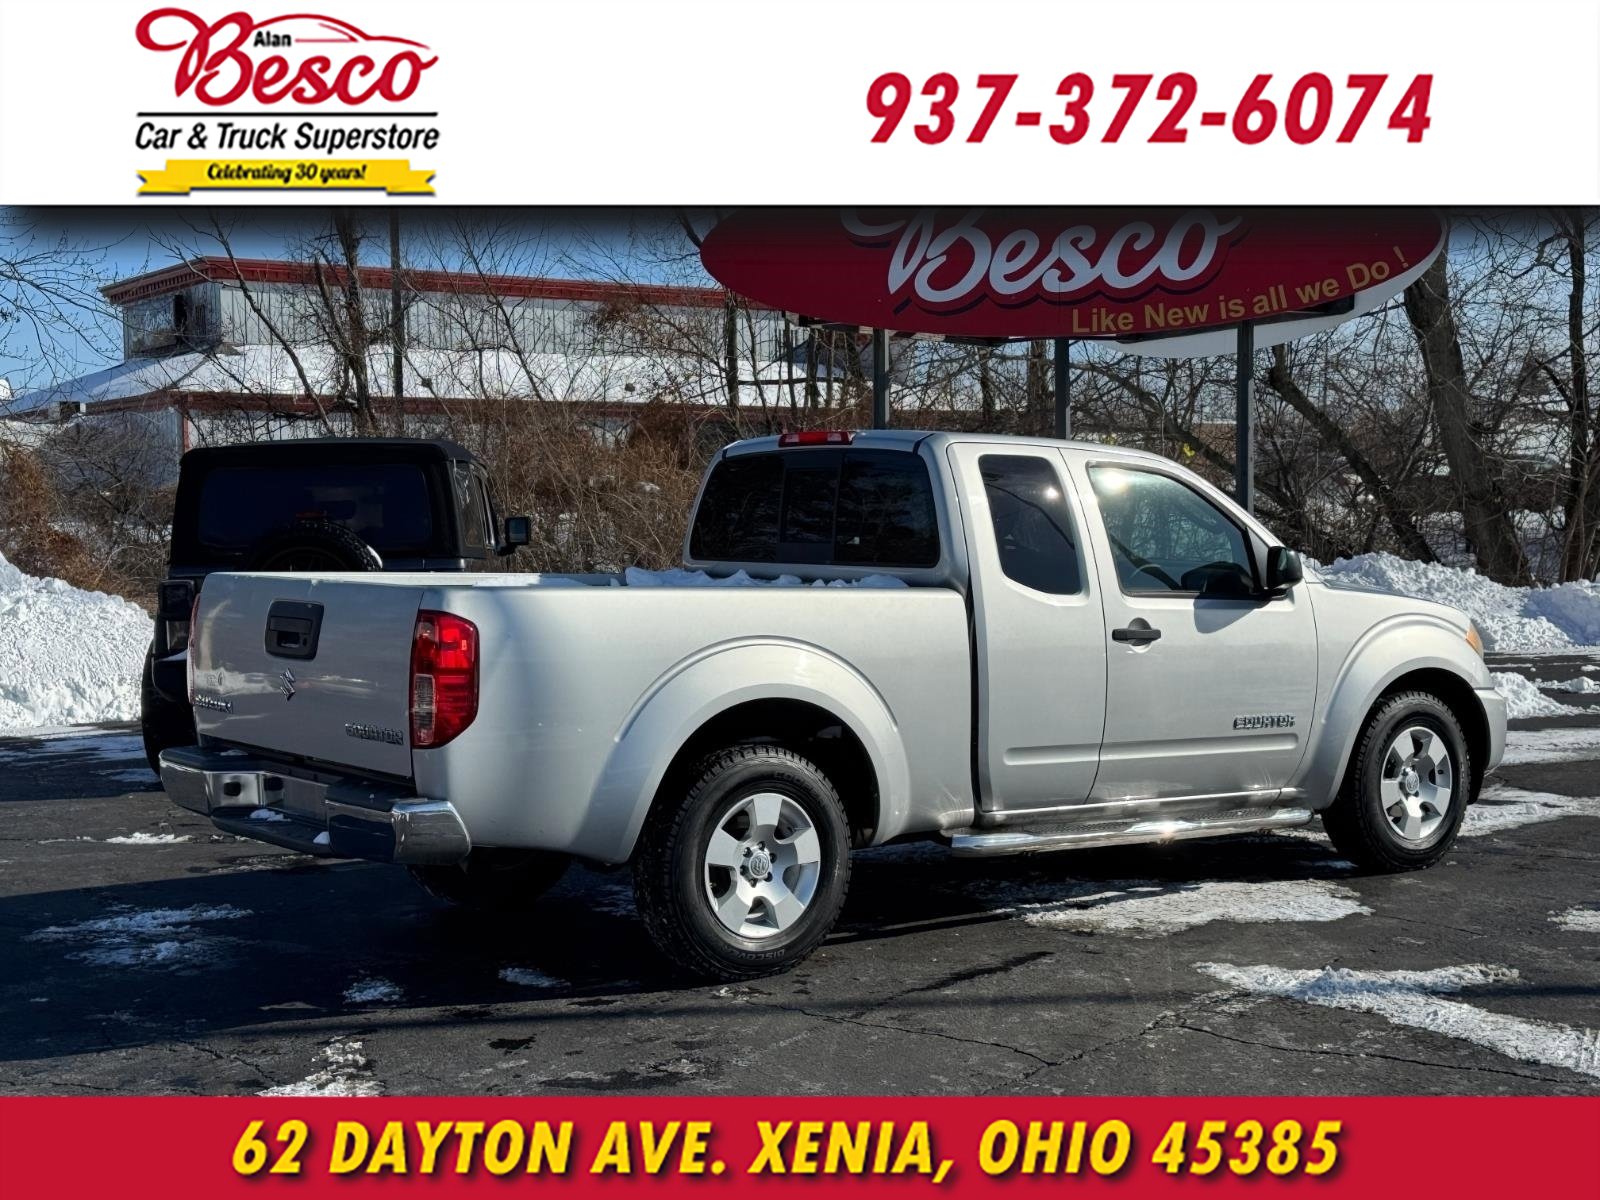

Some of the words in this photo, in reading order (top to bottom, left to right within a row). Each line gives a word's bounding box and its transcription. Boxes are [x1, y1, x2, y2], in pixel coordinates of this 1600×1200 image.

[840, 206, 1242, 302] Besco
[1072, 308, 1134, 333] Like
[1144, 302, 1209, 329] New
[1219, 295, 1246, 319] is
[1253, 284, 1288, 314] all
[1295, 277, 1340, 304] we
[1346, 260, 1390, 290] Do
